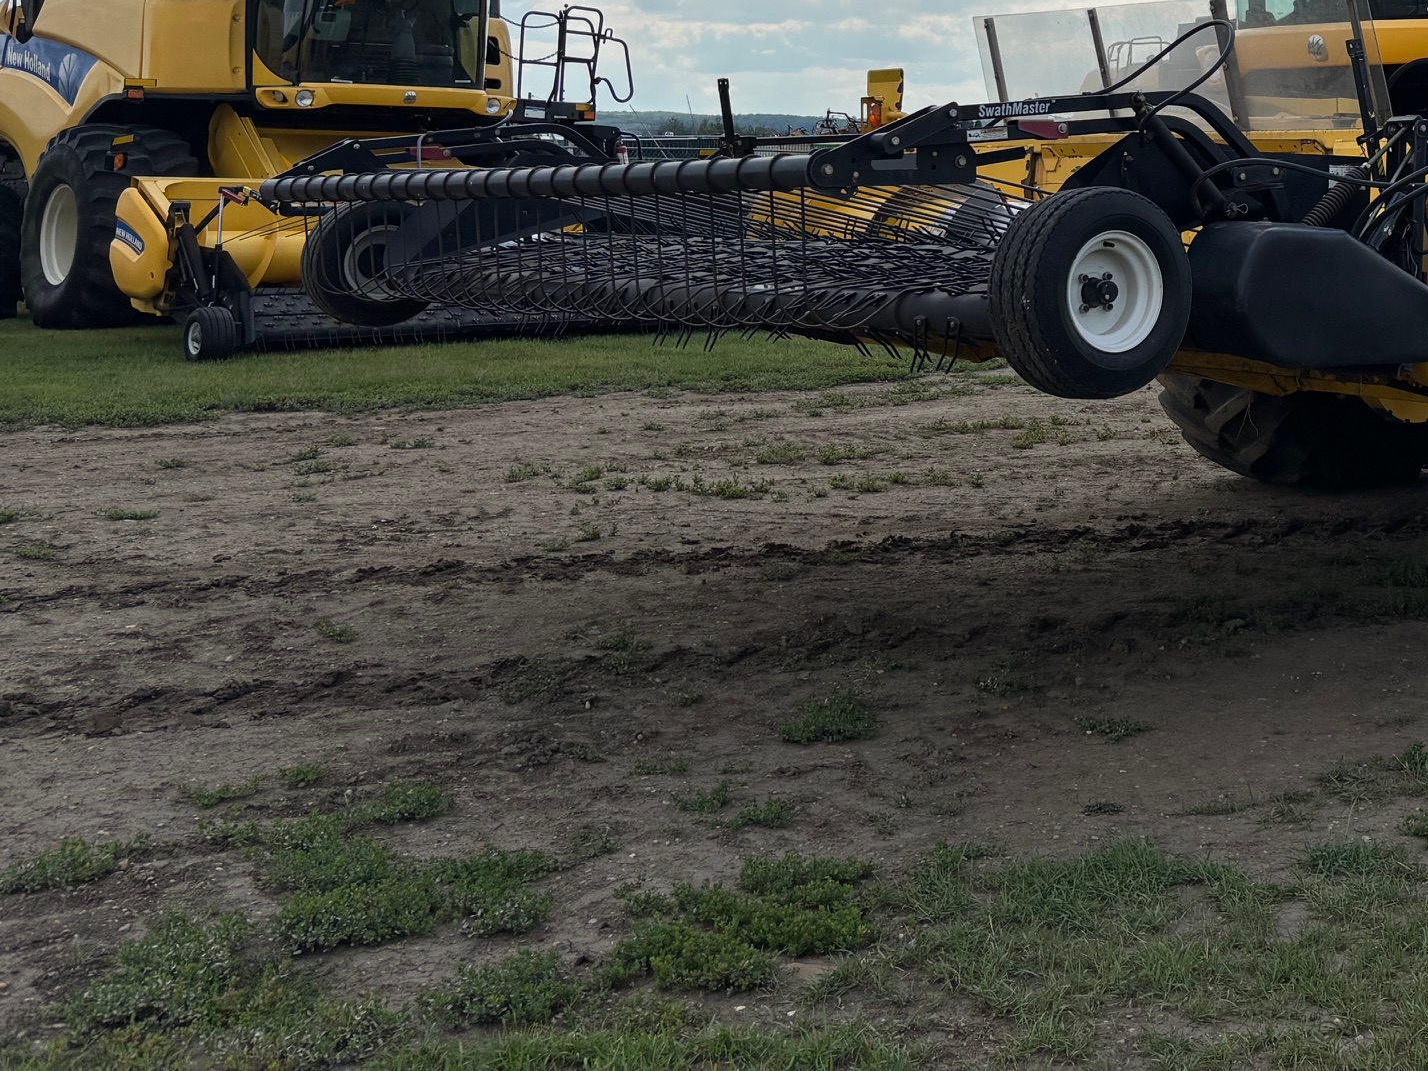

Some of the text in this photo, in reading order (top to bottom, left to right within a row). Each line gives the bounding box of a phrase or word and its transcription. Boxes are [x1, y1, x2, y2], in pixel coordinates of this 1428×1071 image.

[7, 46, 51, 82] New Holland
[978, 102, 1051, 117] SwathMaster
